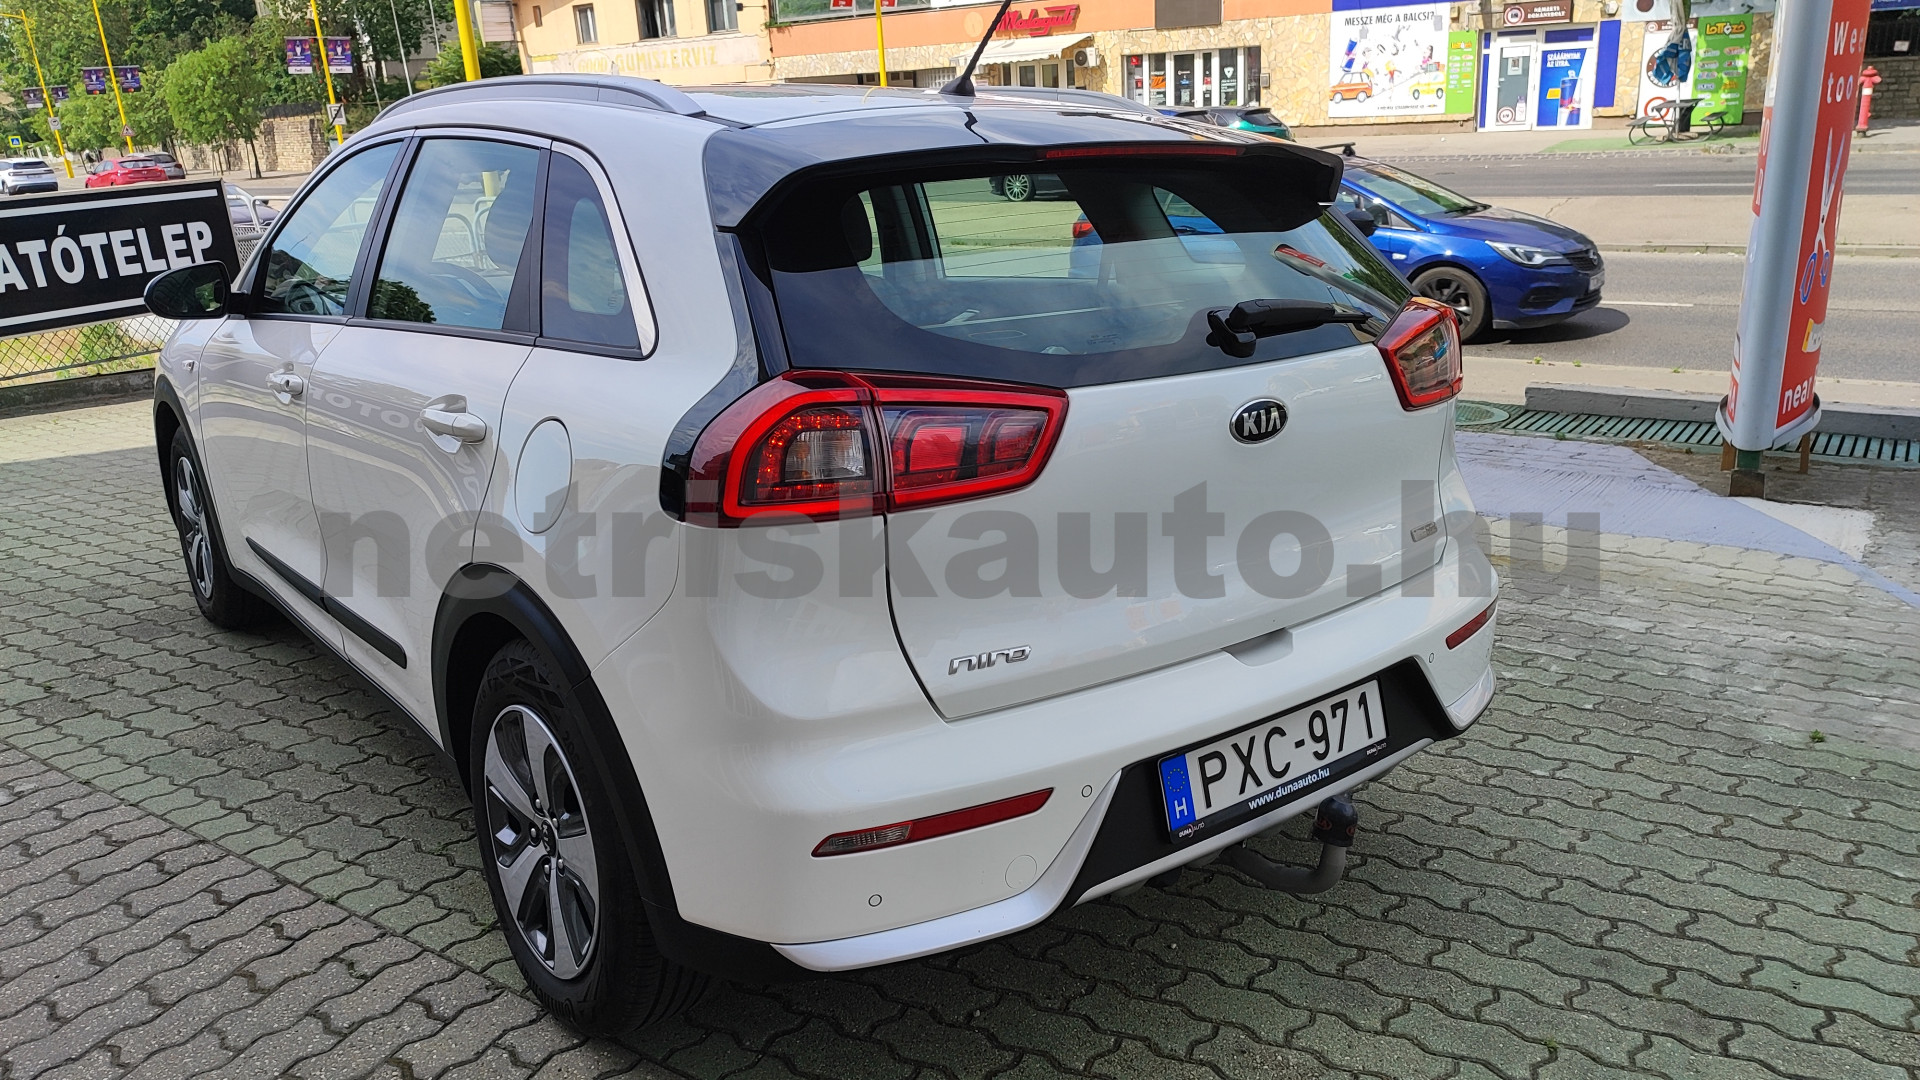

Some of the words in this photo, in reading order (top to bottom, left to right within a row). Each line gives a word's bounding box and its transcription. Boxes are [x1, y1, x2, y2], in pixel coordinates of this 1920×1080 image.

[1345, 16, 1373, 26] MESSZE
[1375, 13, 1393, 24] MÉG
[1395, 14, 1401, 22] A
[1403, 11, 1434, 22] BALCSI?
[615, 46, 718, 72] GUMISZERVIZ
[1827, 72, 1853, 104] too
[0, 221, 213, 294] ATÓTELEP
[1243, 406, 1282, 437] KIA
[948, 645, 1033, 675] niro
[1198, 691, 1374, 809] PXC-971
[1248, 767, 1330, 810] www.dunaauto.hu
[1174, 797, 1188, 819] H
[542, 824, 551, 852] KIA
